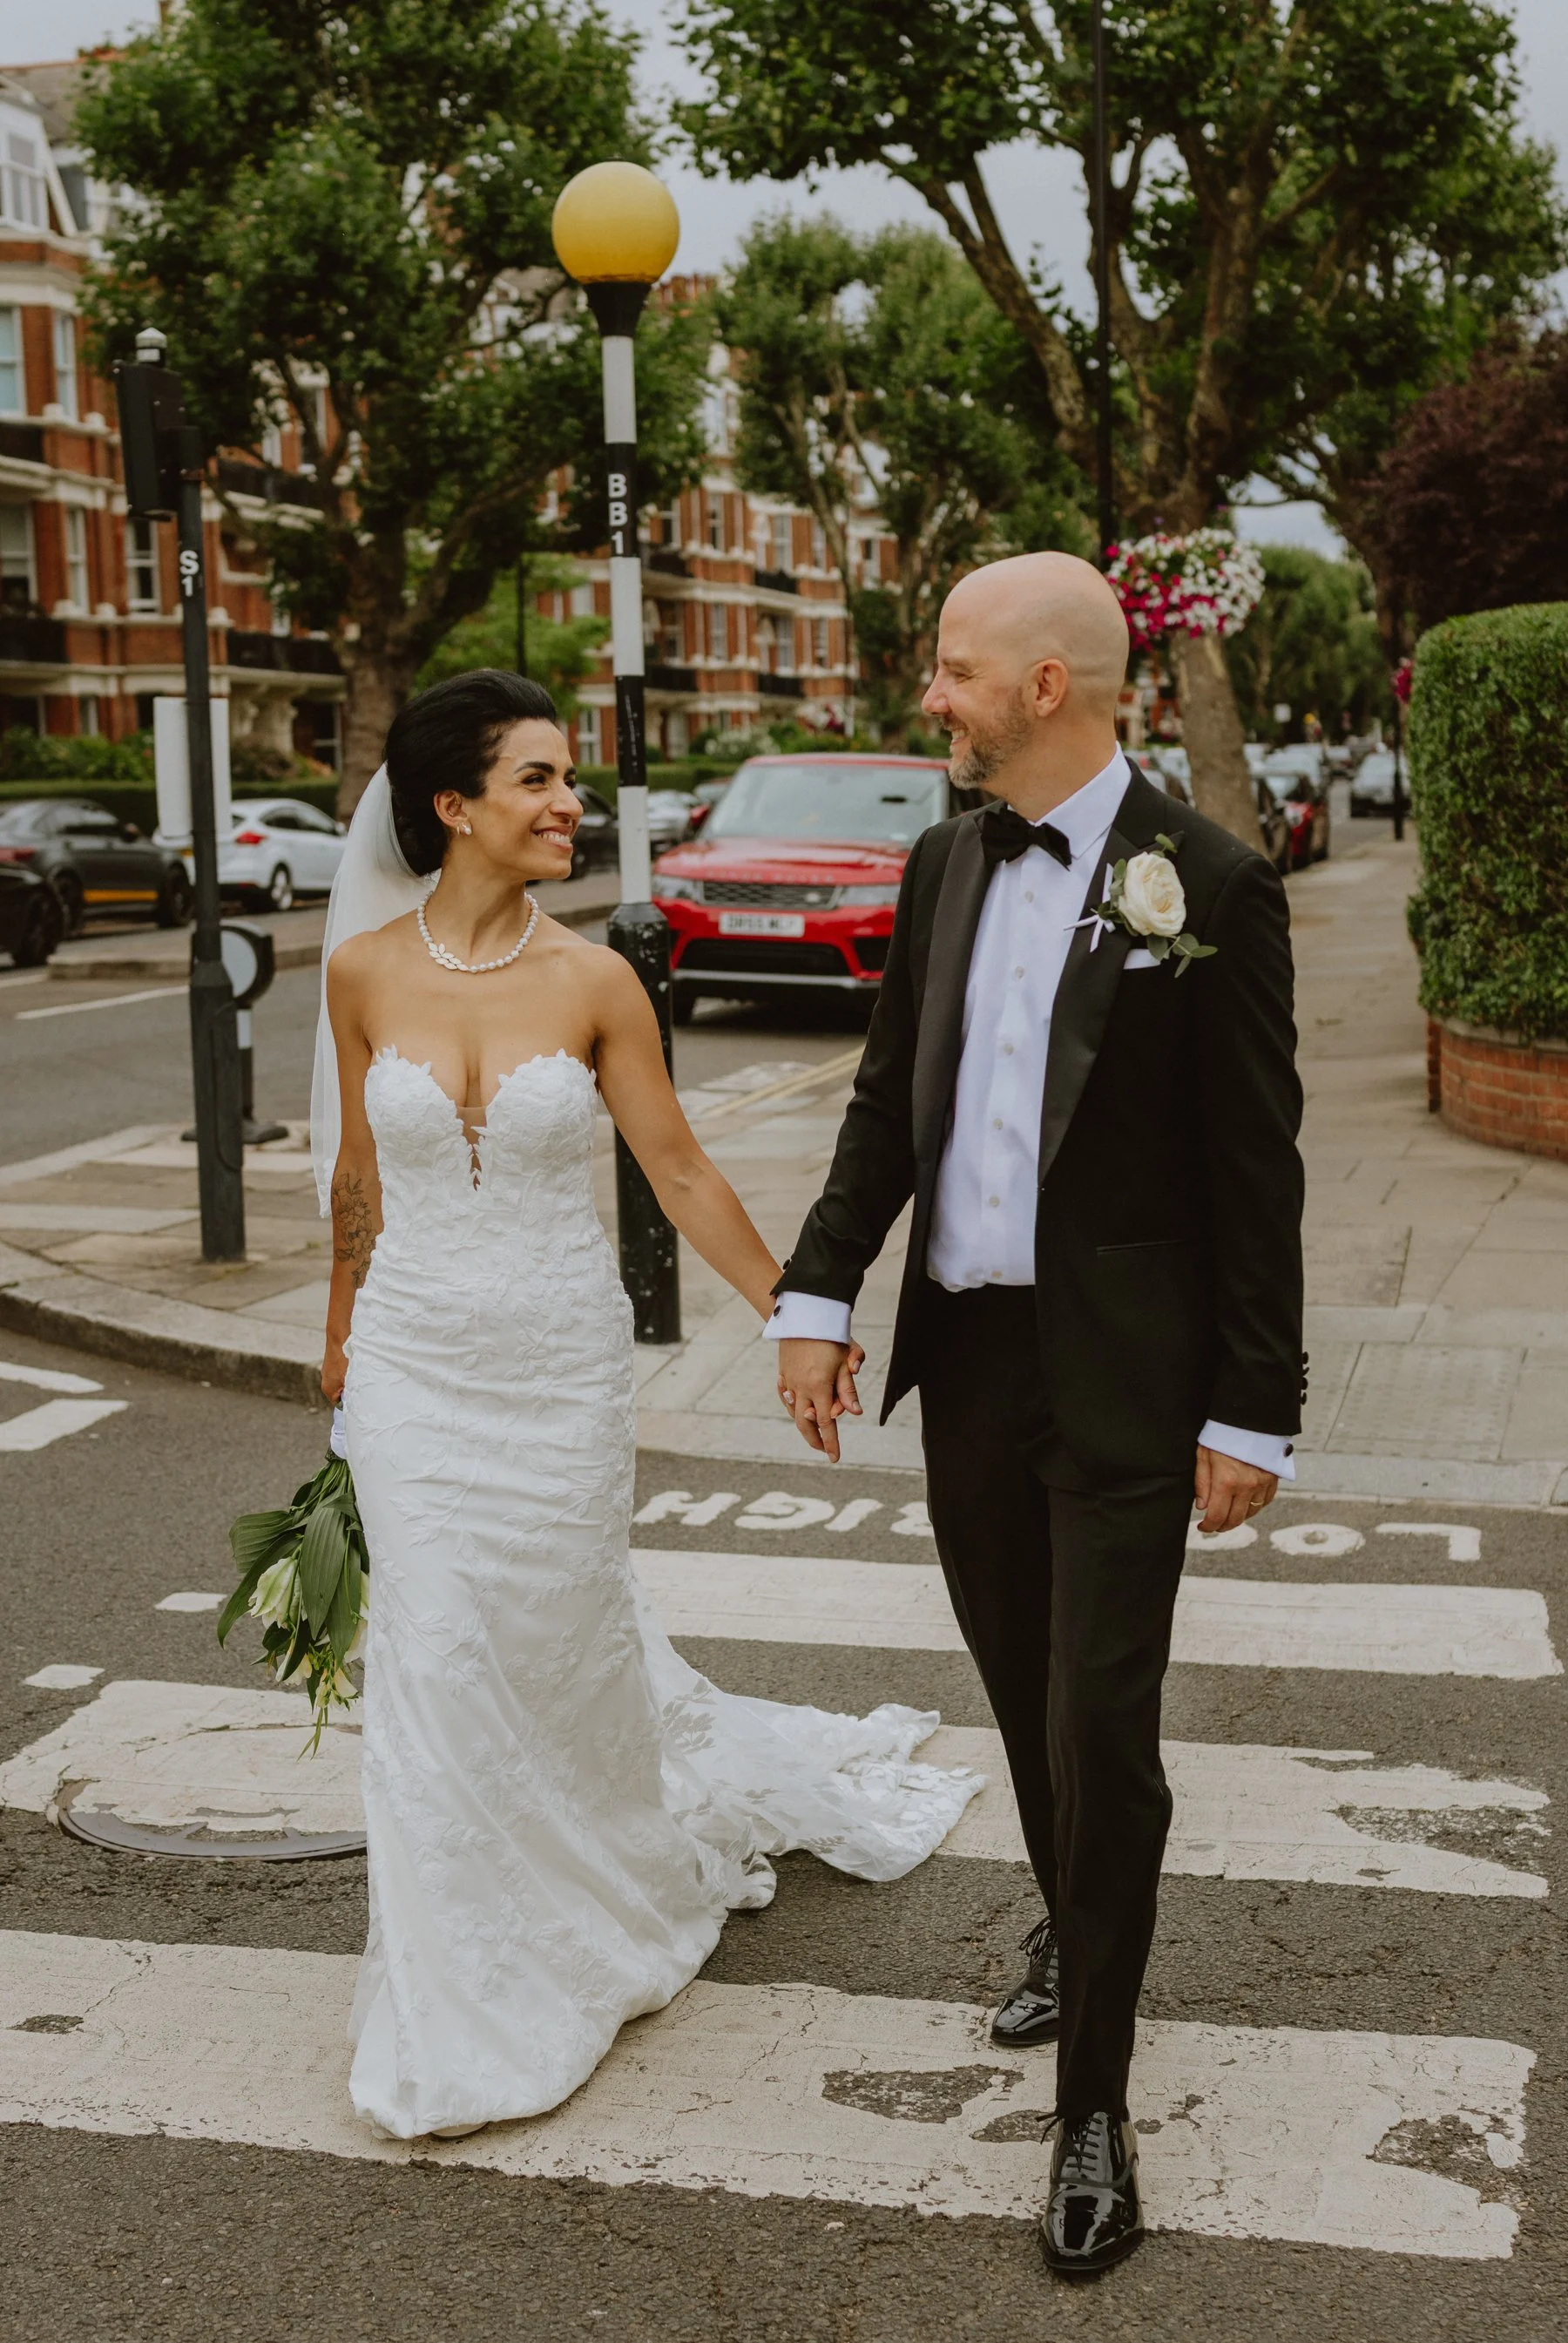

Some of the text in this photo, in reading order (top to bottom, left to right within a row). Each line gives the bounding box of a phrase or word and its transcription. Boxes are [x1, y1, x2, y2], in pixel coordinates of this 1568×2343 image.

[608, 473, 628, 555] BB1
[179, 550, 199, 597] S1
[632, 1490, 1482, 1561] LOO RIGH
